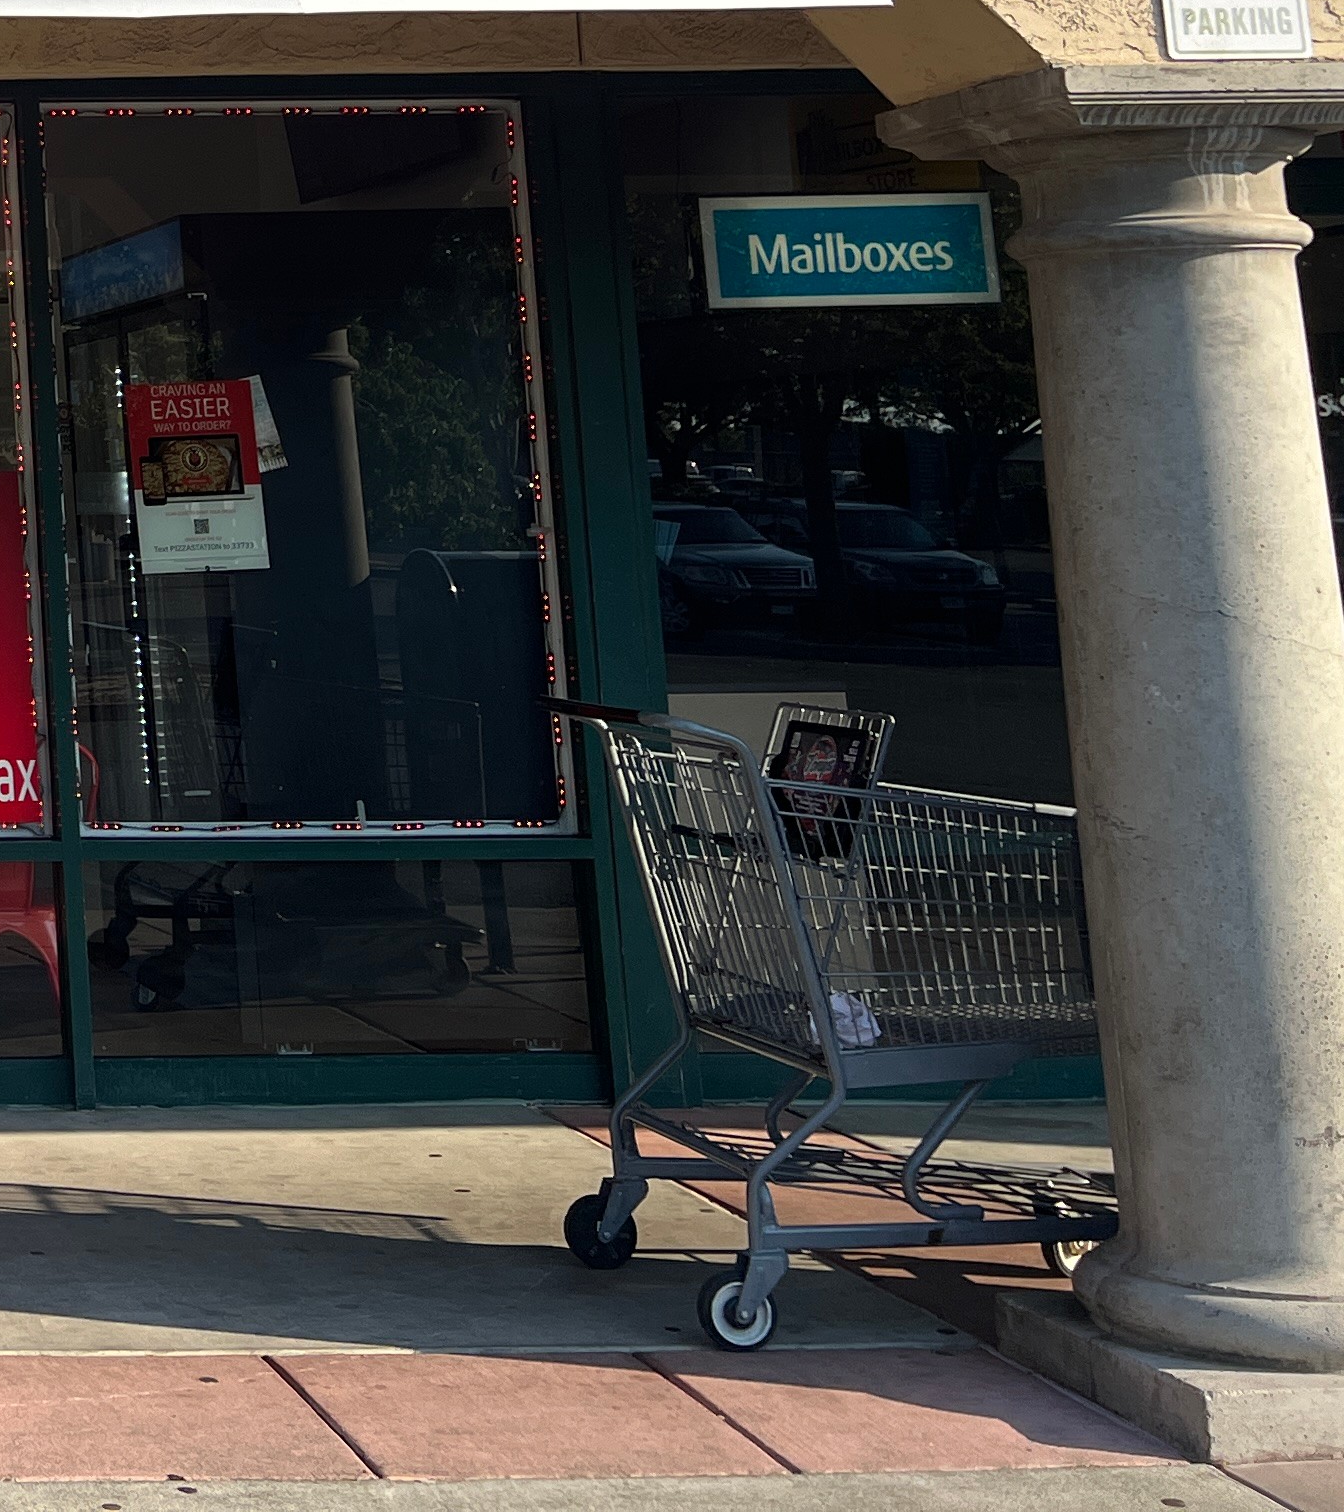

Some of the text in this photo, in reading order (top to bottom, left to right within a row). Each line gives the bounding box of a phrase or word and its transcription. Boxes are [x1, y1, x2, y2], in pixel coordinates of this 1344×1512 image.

[1180, 6, 1295, 36] PARKING
[748, 232, 954, 275] Mailboxes
[150, 382, 226, 398] CRAVING AN
[150, 396, 231, 421] EASIER
[153, 419, 232, 433] WAY TO ORDER?
